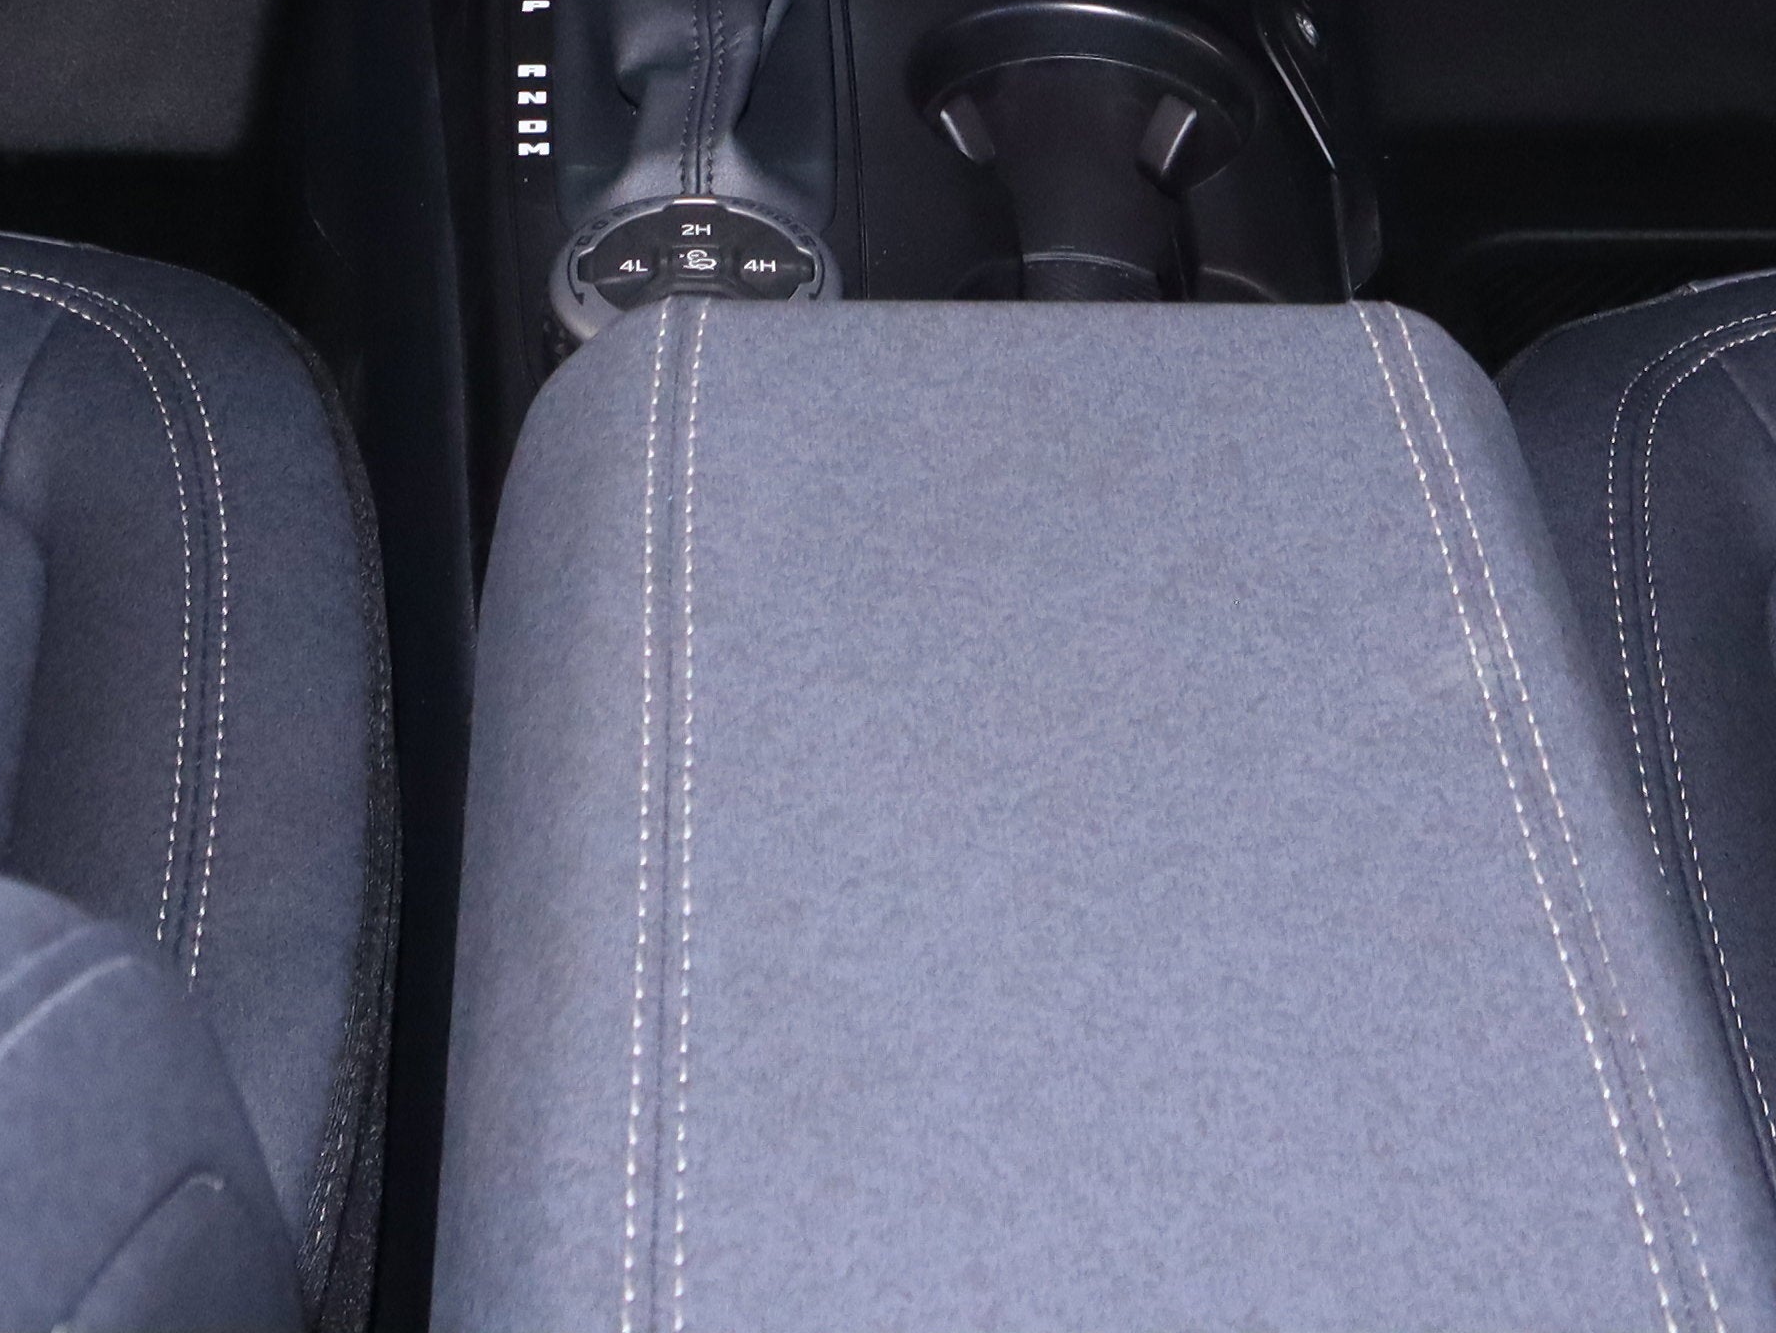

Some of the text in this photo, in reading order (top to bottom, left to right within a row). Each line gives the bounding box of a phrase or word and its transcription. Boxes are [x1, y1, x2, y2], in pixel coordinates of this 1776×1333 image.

[522, 0, 550, 12] P
[517, 91, 547, 104] N
[517, 120, 547, 133] D
[517, 142, 550, 156] M
[681, 224, 712, 236] 2H
[619, 260, 649, 272] 4L
[743, 260, 777, 272] 4H
